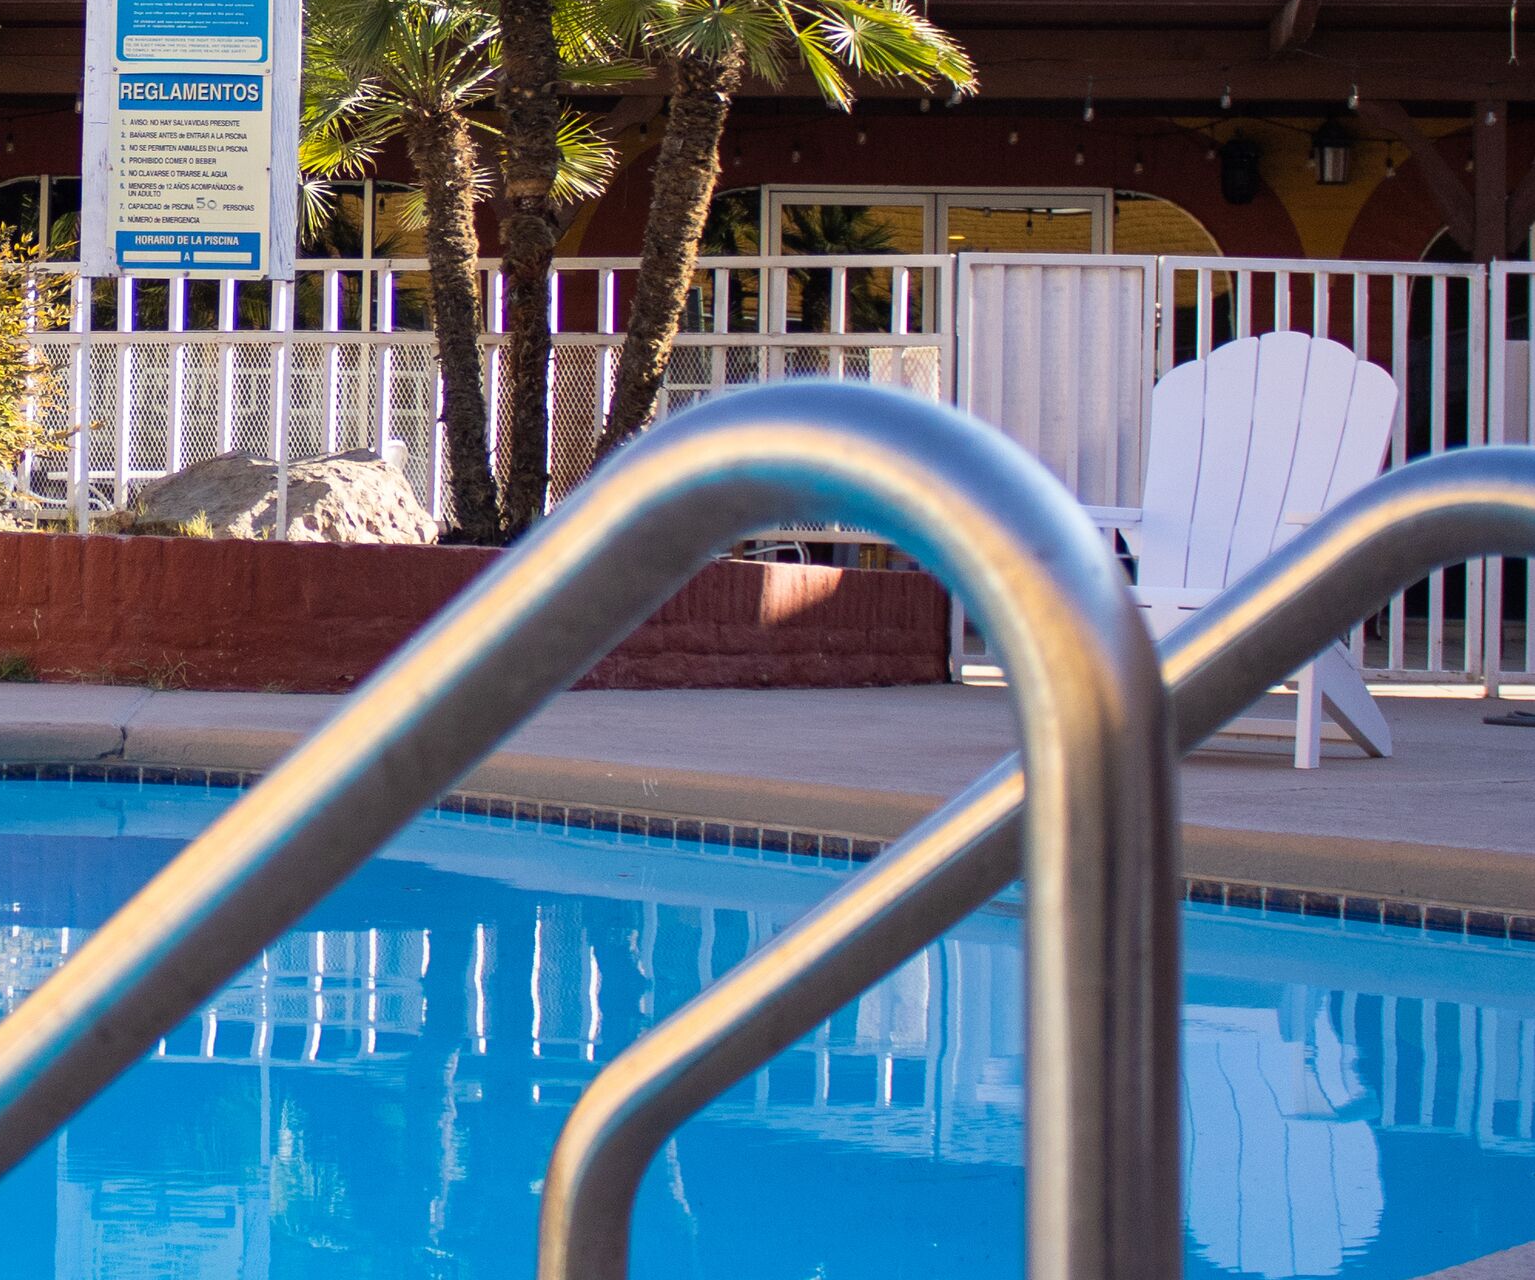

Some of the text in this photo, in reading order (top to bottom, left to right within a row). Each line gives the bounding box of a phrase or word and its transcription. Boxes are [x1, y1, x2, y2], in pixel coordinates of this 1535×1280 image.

[120, 82, 259, 102] REGLAMENTOS
[150, 118, 159, 126] NO
[160, 118, 172, 126] HAY
[173, 118, 209, 127] SALVAVIDAS
[210, 119, 240, 127] PRESENTE
[129, 130, 157, 138] BAÑARSE
[225, 132, 247, 140] PISCINA
[148, 144, 177, 152] PERMITEN
[225, 145, 248, 153] PISCINA
[195, 157, 216, 165] BEBER
[173, 181, 189, 190] AÑOS
[191, 182, 236, 191] ACOMPAÑADOS
[196, 197, 217, 210] 50
[127, 214, 153, 223] NÚMERO
[161, 216, 200, 224] EMERGENCIA
[135, 235, 239, 245] HORARIO DE LA PISCINA
[183, 252, 191, 261] A
